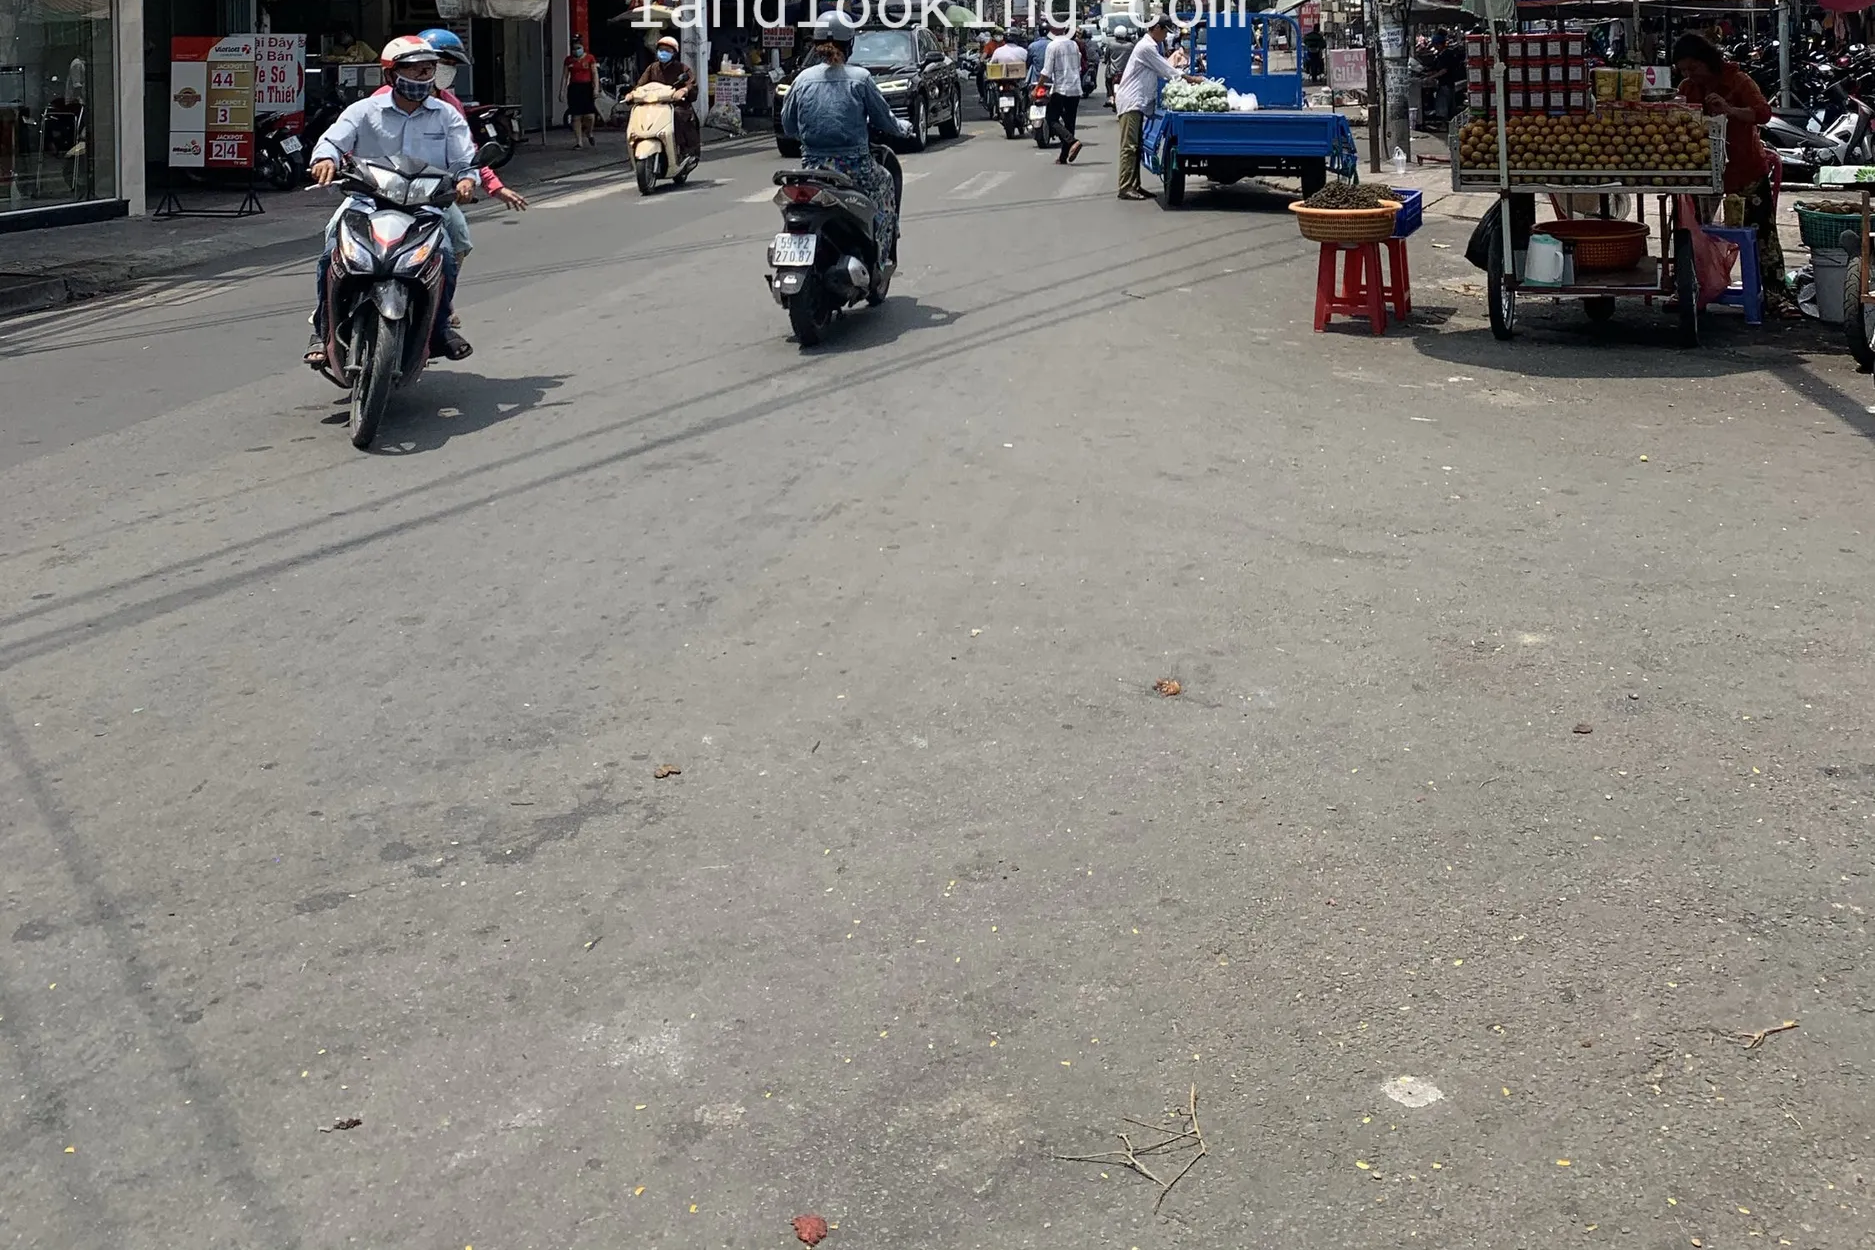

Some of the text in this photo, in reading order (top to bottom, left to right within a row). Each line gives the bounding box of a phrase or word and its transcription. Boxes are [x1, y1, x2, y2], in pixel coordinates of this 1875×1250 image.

[268, 37, 294, 49] Đây
[267, 50, 293, 61] Bán
[213, 73, 233, 87] 44
[271, 65, 287, 83] Số
[267, 85, 295, 103] Thiết
[219, 109, 228, 123] 3
[780, 236, 809, 249] 59-P2
